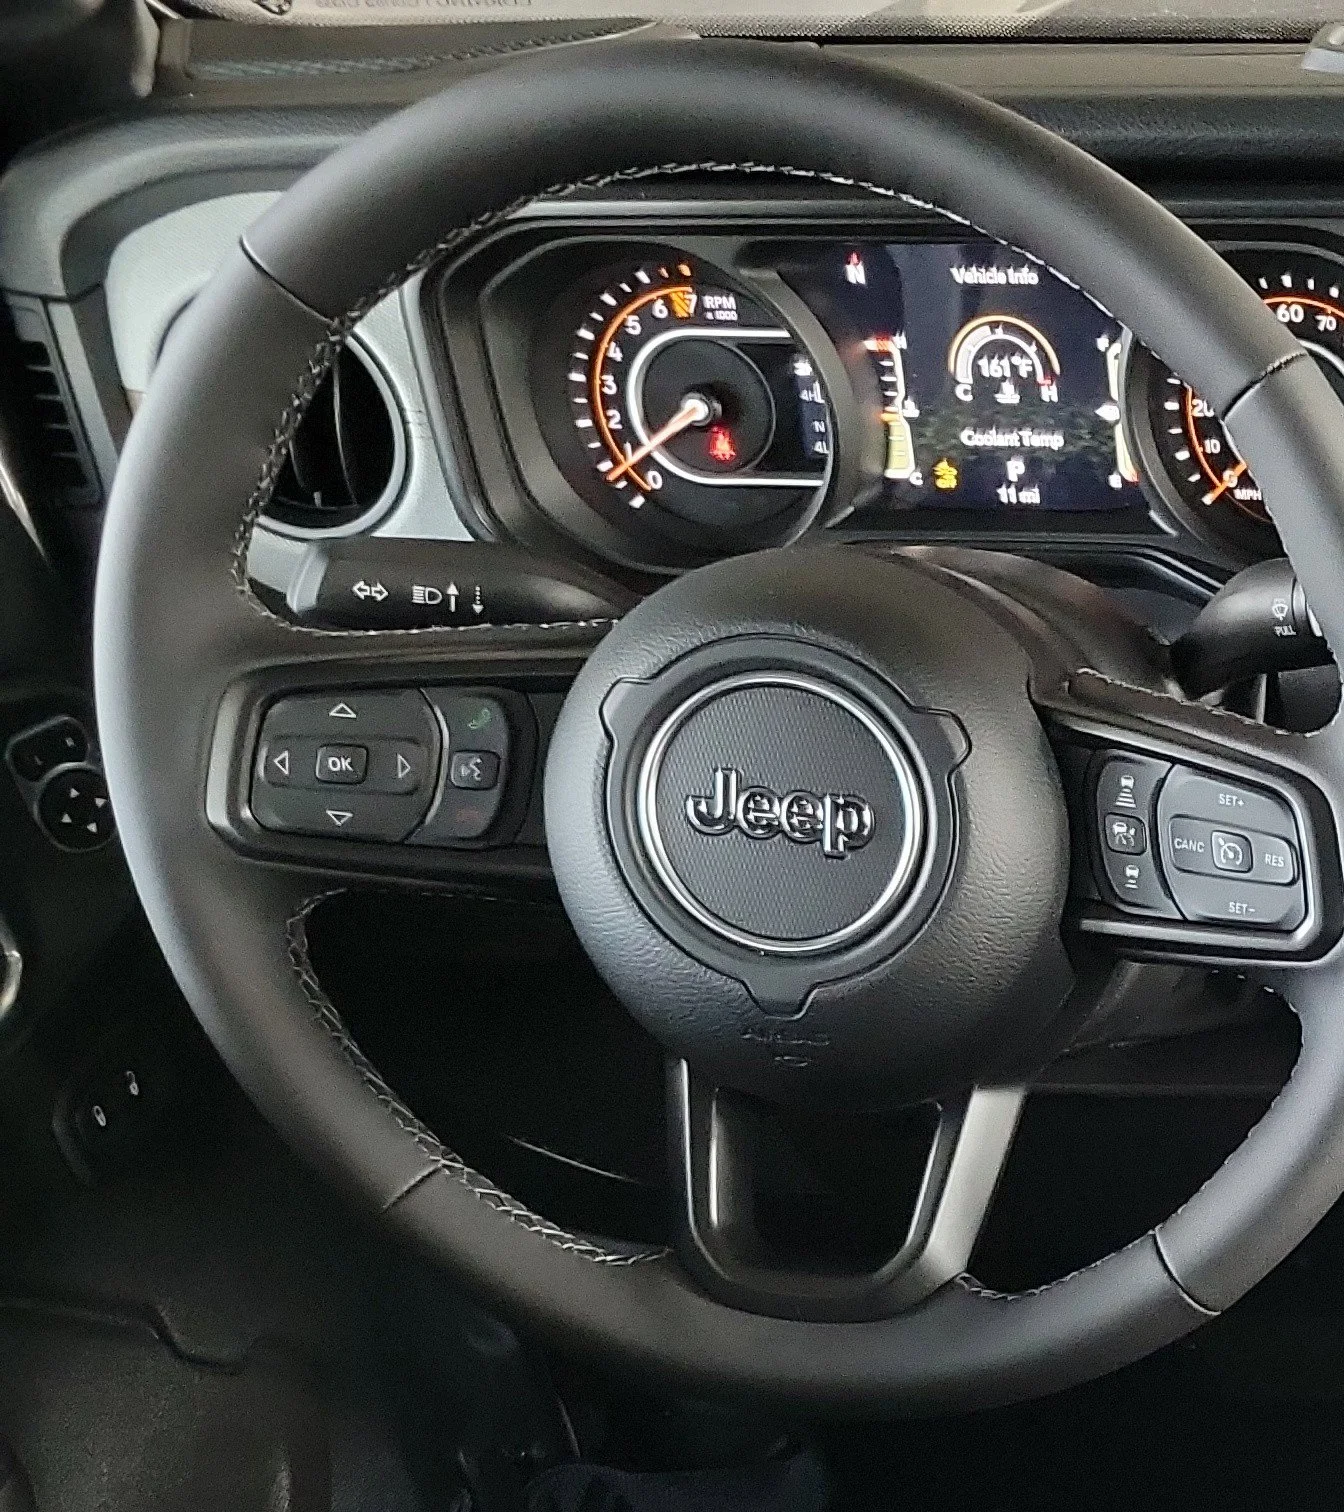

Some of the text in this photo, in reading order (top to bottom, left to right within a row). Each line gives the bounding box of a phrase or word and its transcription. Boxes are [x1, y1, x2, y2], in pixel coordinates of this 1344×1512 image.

[950, 264, 1039, 285] Vehicle Info
[652, 298, 668, 319] 6
[702, 294, 737, 310] RPM
[1276, 302, 1304, 323] 60
[624, 314, 642, 335] 5
[1316, 315, 1337, 331] 70
[607, 341, 623, 362] 4
[601, 375, 618, 395] 3
[955, 384, 973, 402] C
[1041, 385, 1058, 403] H
[607, 410, 622, 430] 2
[960, 429, 1064, 451] Coolant Temp
[1204, 439, 1221, 455] 10
[1006, 457, 1025, 482] P
[1233, 488, 1262, 501] MPH
[327, 755, 355, 774] OK
[1219, 793, 1245, 808] SET+
[685, 766, 876, 859] Jeep
[1174, 837, 1205, 854] CANC
[1265, 853, 1285, 868] RES
